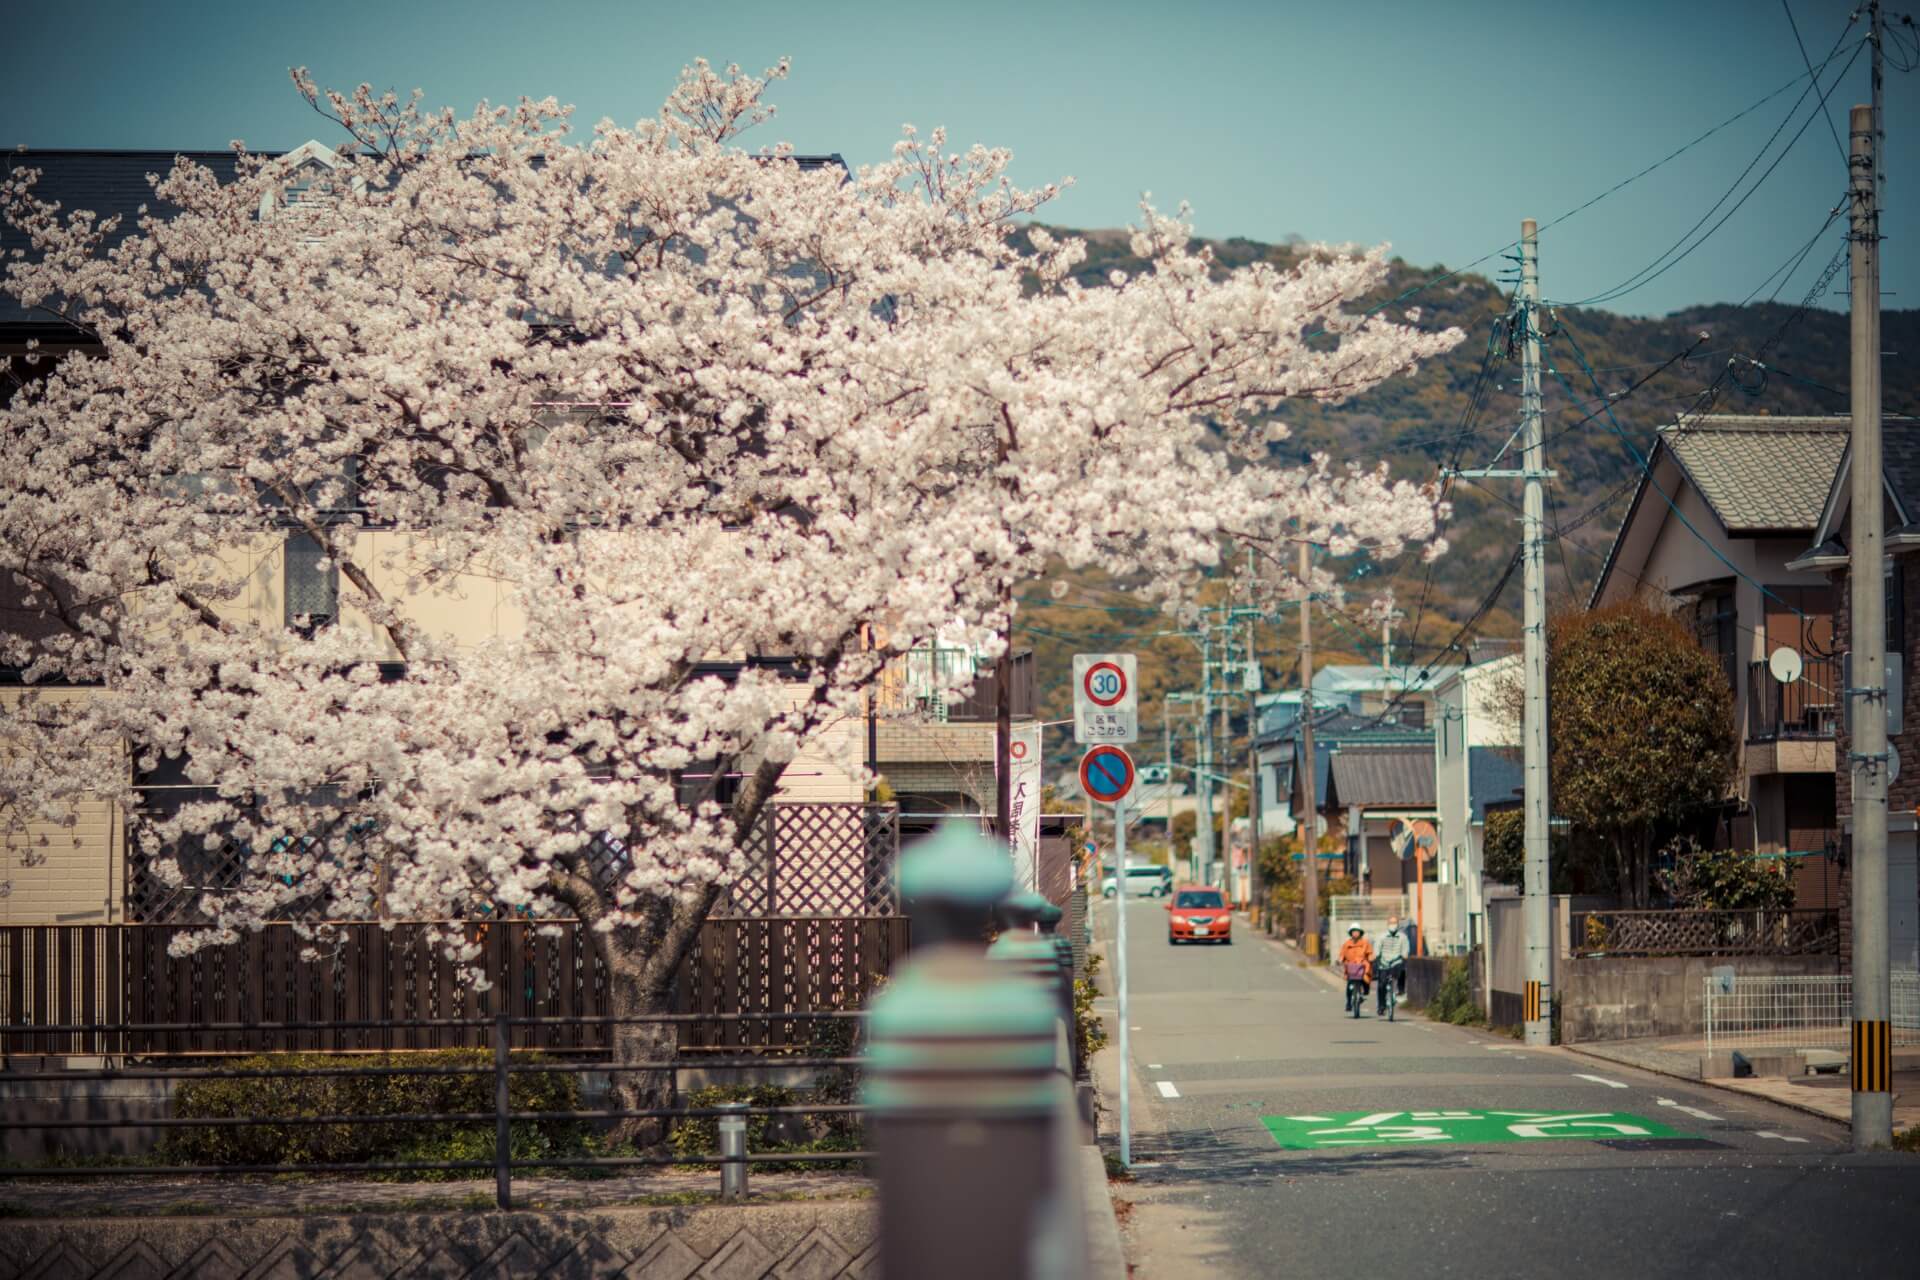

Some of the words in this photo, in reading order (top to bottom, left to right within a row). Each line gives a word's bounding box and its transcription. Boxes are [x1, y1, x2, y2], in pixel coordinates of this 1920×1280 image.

[1093, 674, 1119, 695] 30
[1087, 726, 1127, 736] ここから
